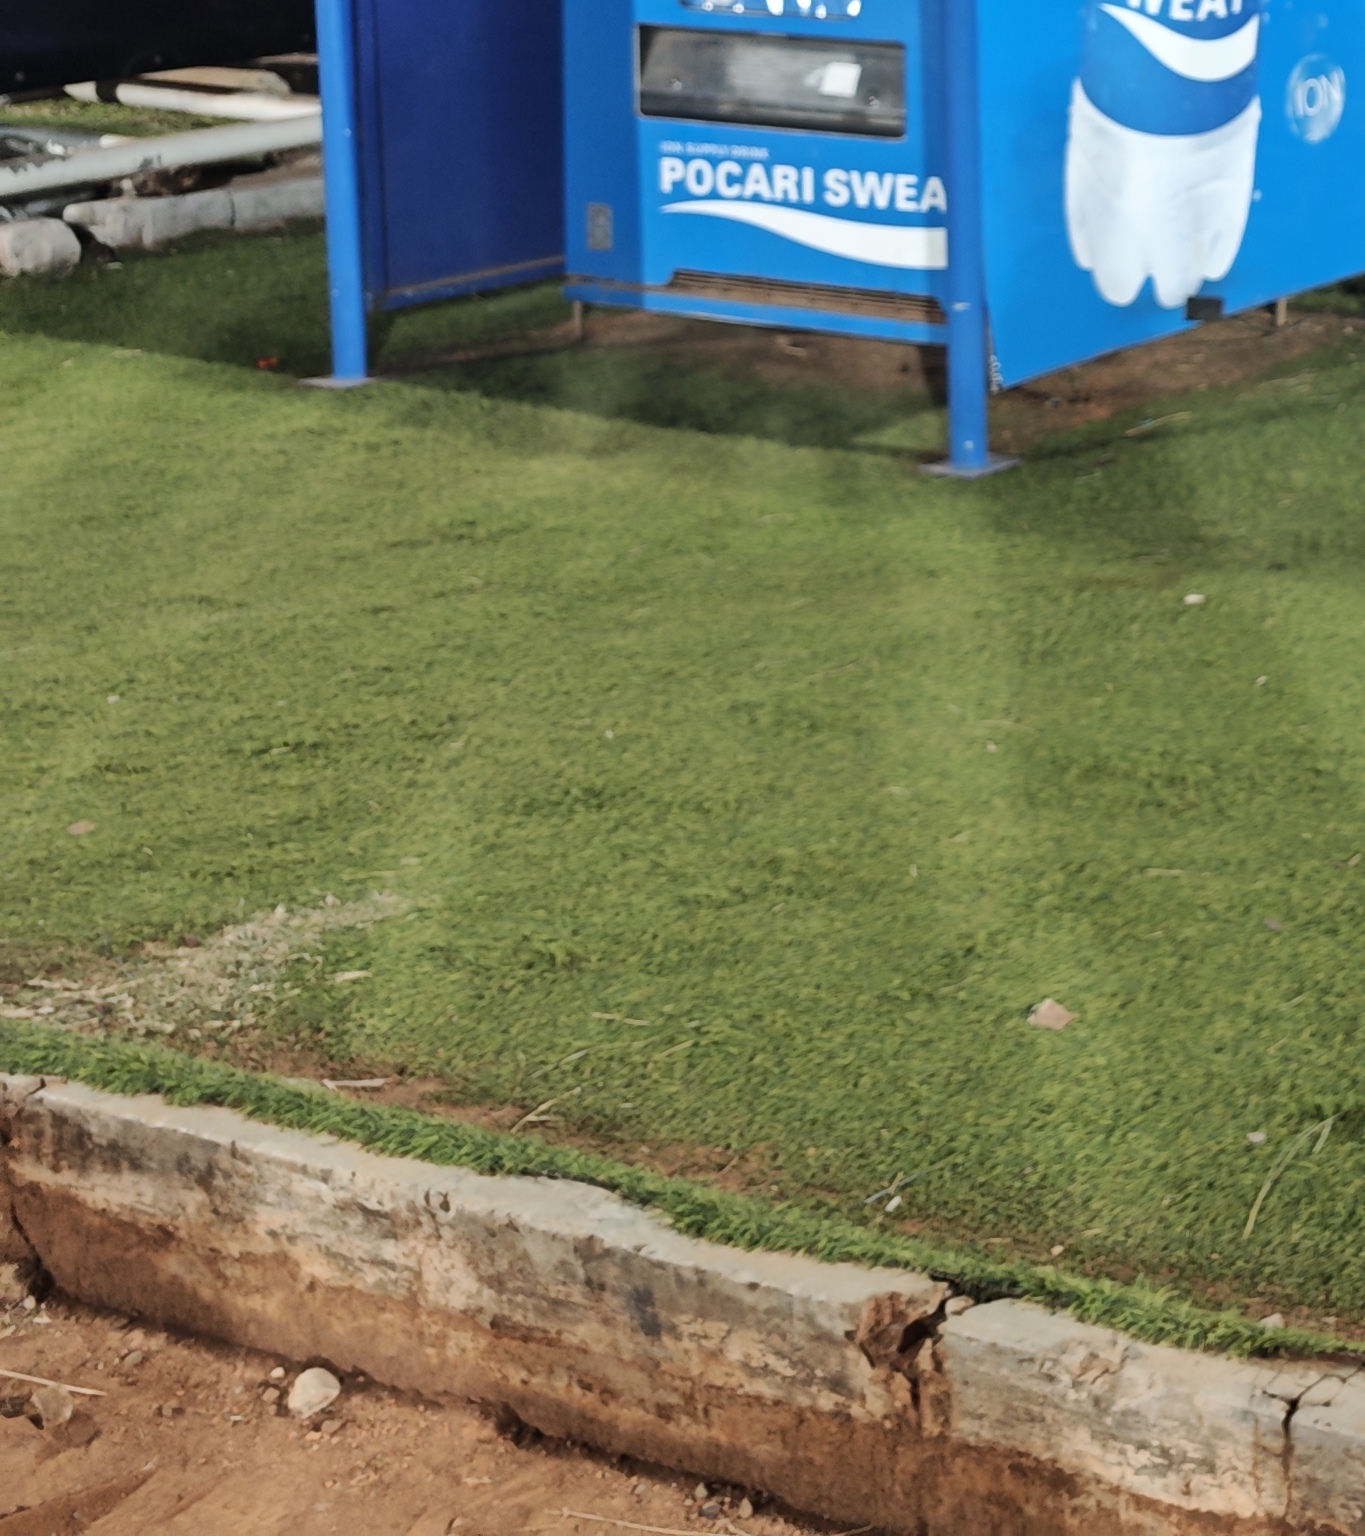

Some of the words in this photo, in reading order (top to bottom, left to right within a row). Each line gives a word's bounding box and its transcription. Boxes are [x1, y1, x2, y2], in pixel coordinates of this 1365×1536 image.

[1294, 69, 1342, 118] ION
[659, 156, 815, 205] POCARI
[824, 168, 948, 215] SWEA
